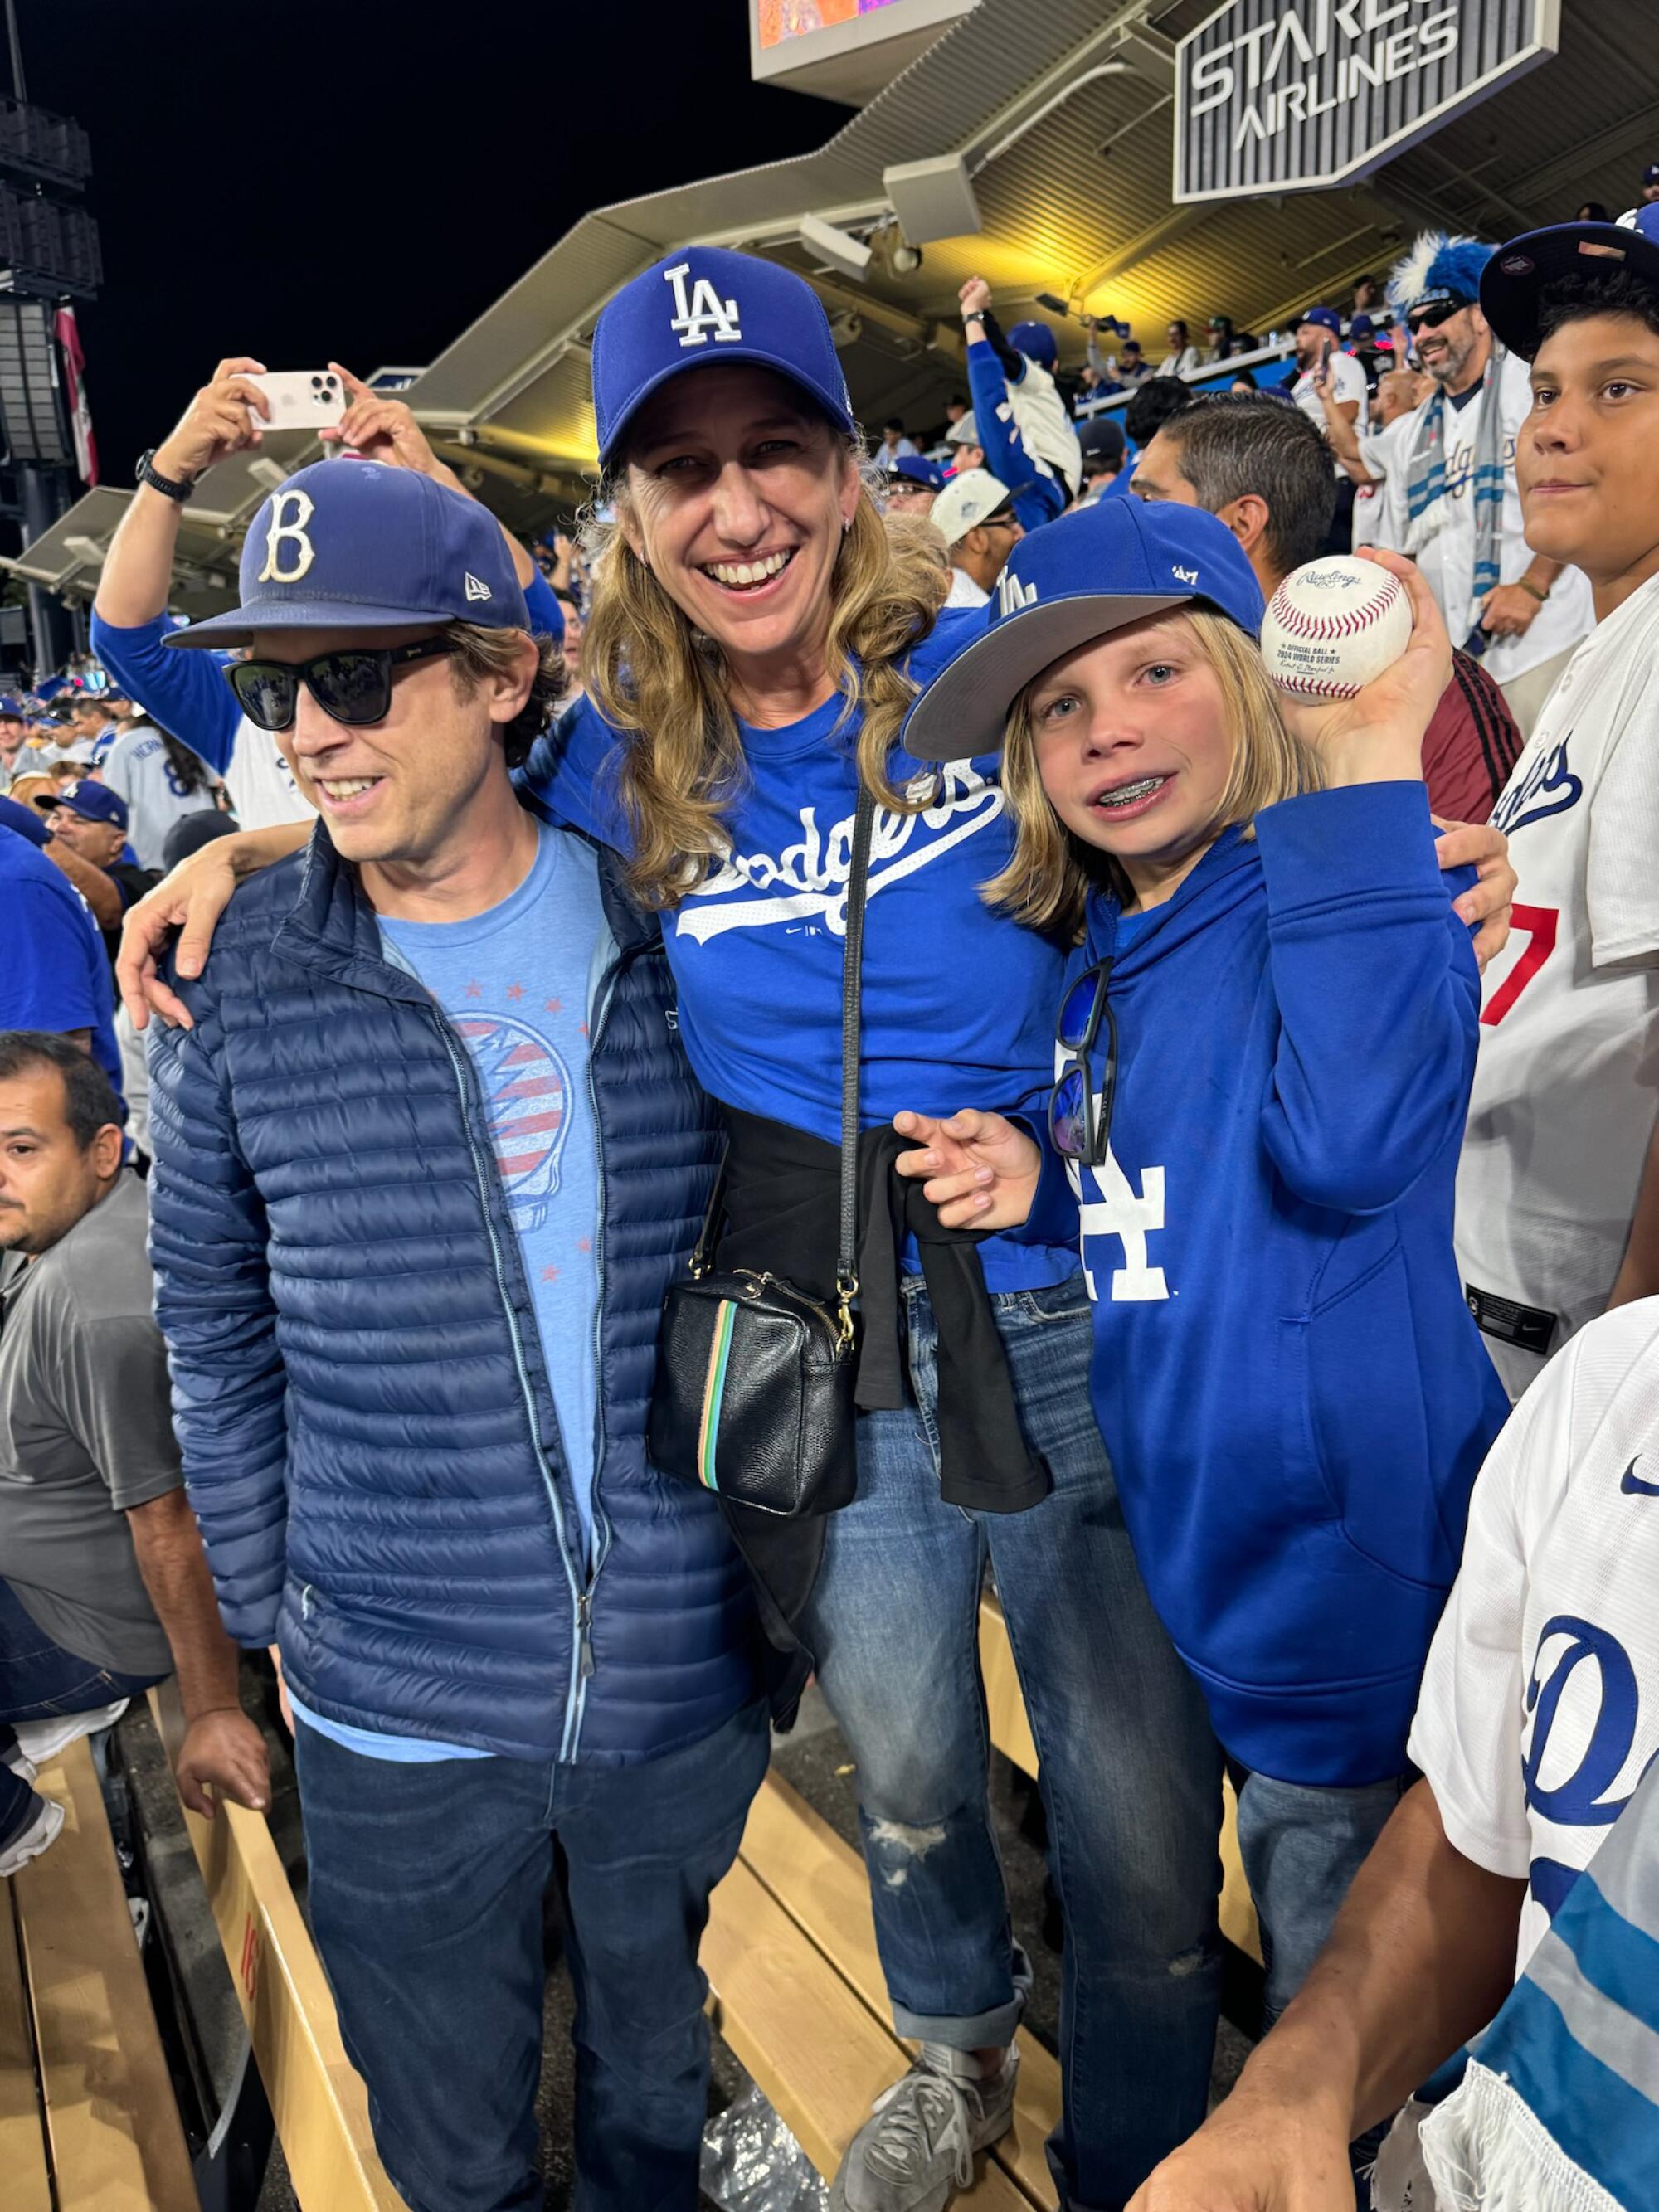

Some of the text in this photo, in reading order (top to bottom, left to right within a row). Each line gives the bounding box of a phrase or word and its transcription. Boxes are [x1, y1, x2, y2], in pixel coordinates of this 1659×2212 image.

[1191, 0, 1433, 118] STARL
[1233, 7, 1458, 151] AIRLINES
[664, 263, 742, 347] LA
[258, 489, 315, 582] B
[1293, 653, 1316, 663] WORLD
[1316, 655, 1341, 664] SERIES
